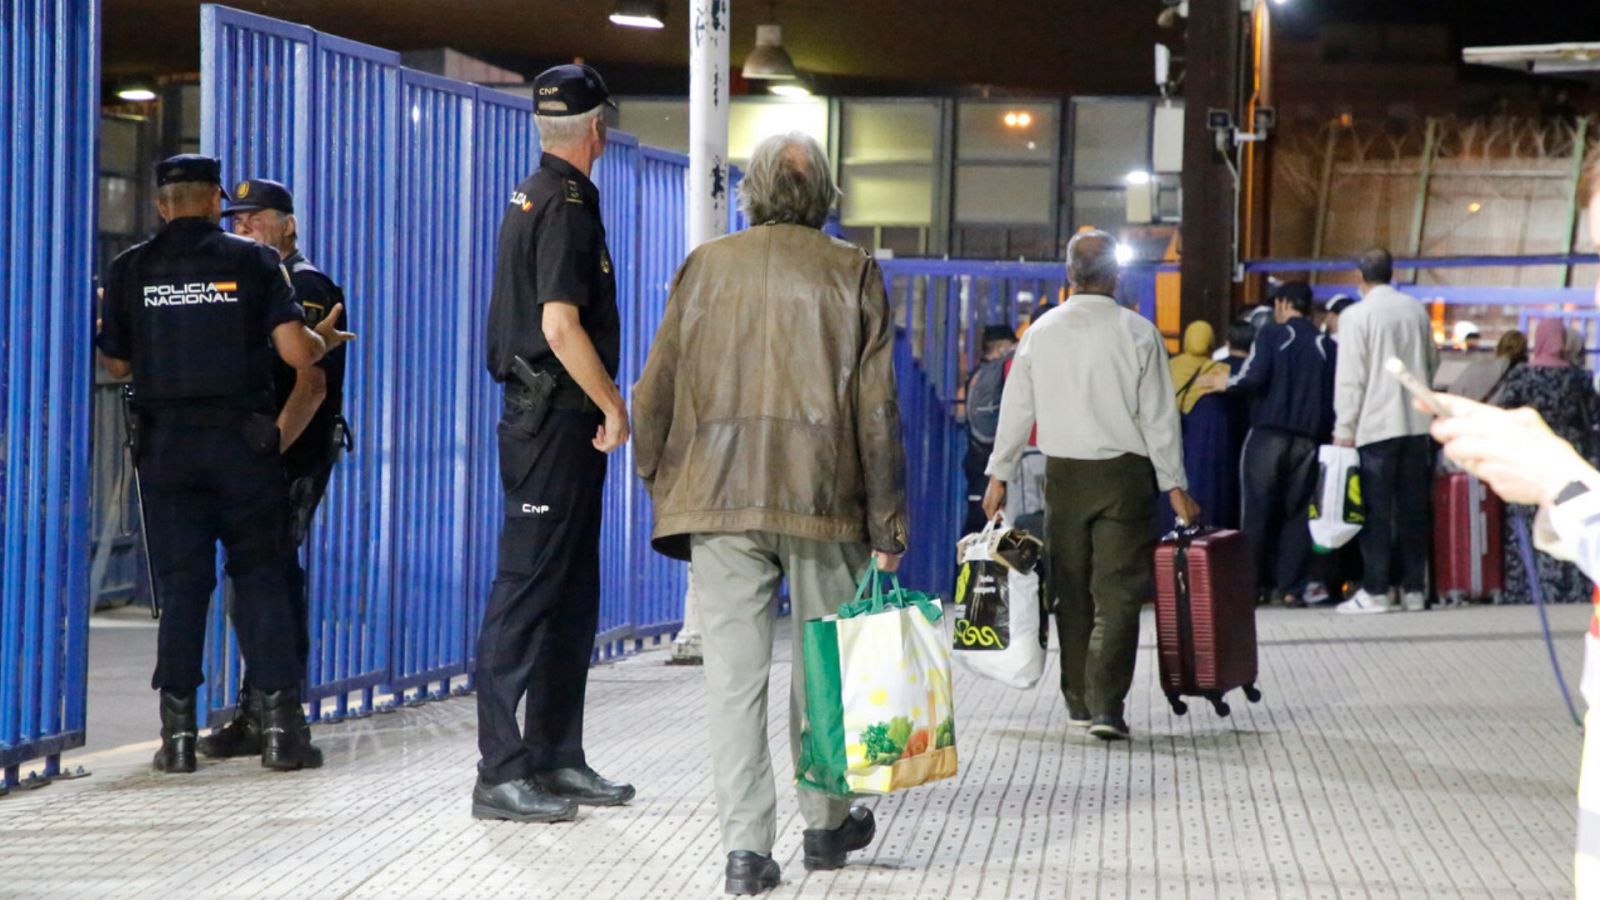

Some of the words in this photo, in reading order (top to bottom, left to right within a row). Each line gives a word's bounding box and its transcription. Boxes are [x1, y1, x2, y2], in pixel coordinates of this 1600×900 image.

[539, 86, 559, 96] CNP
[143, 282, 218, 296] POLICIA
[144, 292, 239, 307] NACIONAL
[521, 503, 550, 515] CNP
